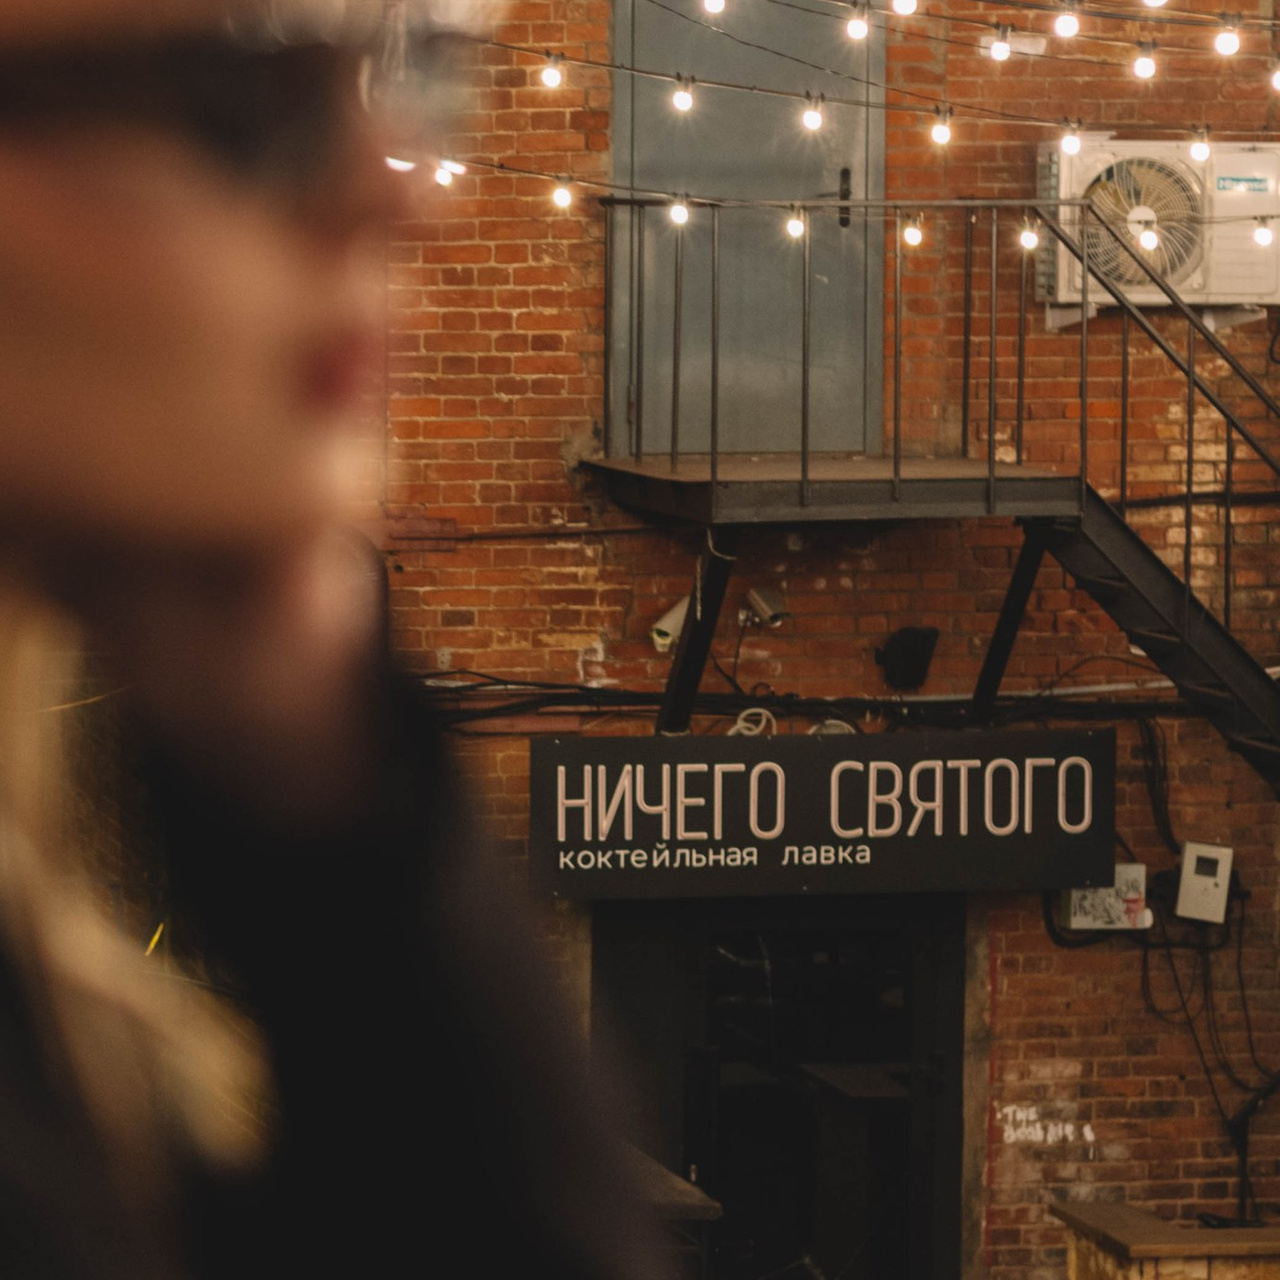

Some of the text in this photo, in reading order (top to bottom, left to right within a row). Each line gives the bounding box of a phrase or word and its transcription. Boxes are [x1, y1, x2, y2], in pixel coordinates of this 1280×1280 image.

[557, 756, 1093, 842] НИЧЕГО СВЯТОГО
[559, 843, 871, 869] коктейльная лавка
